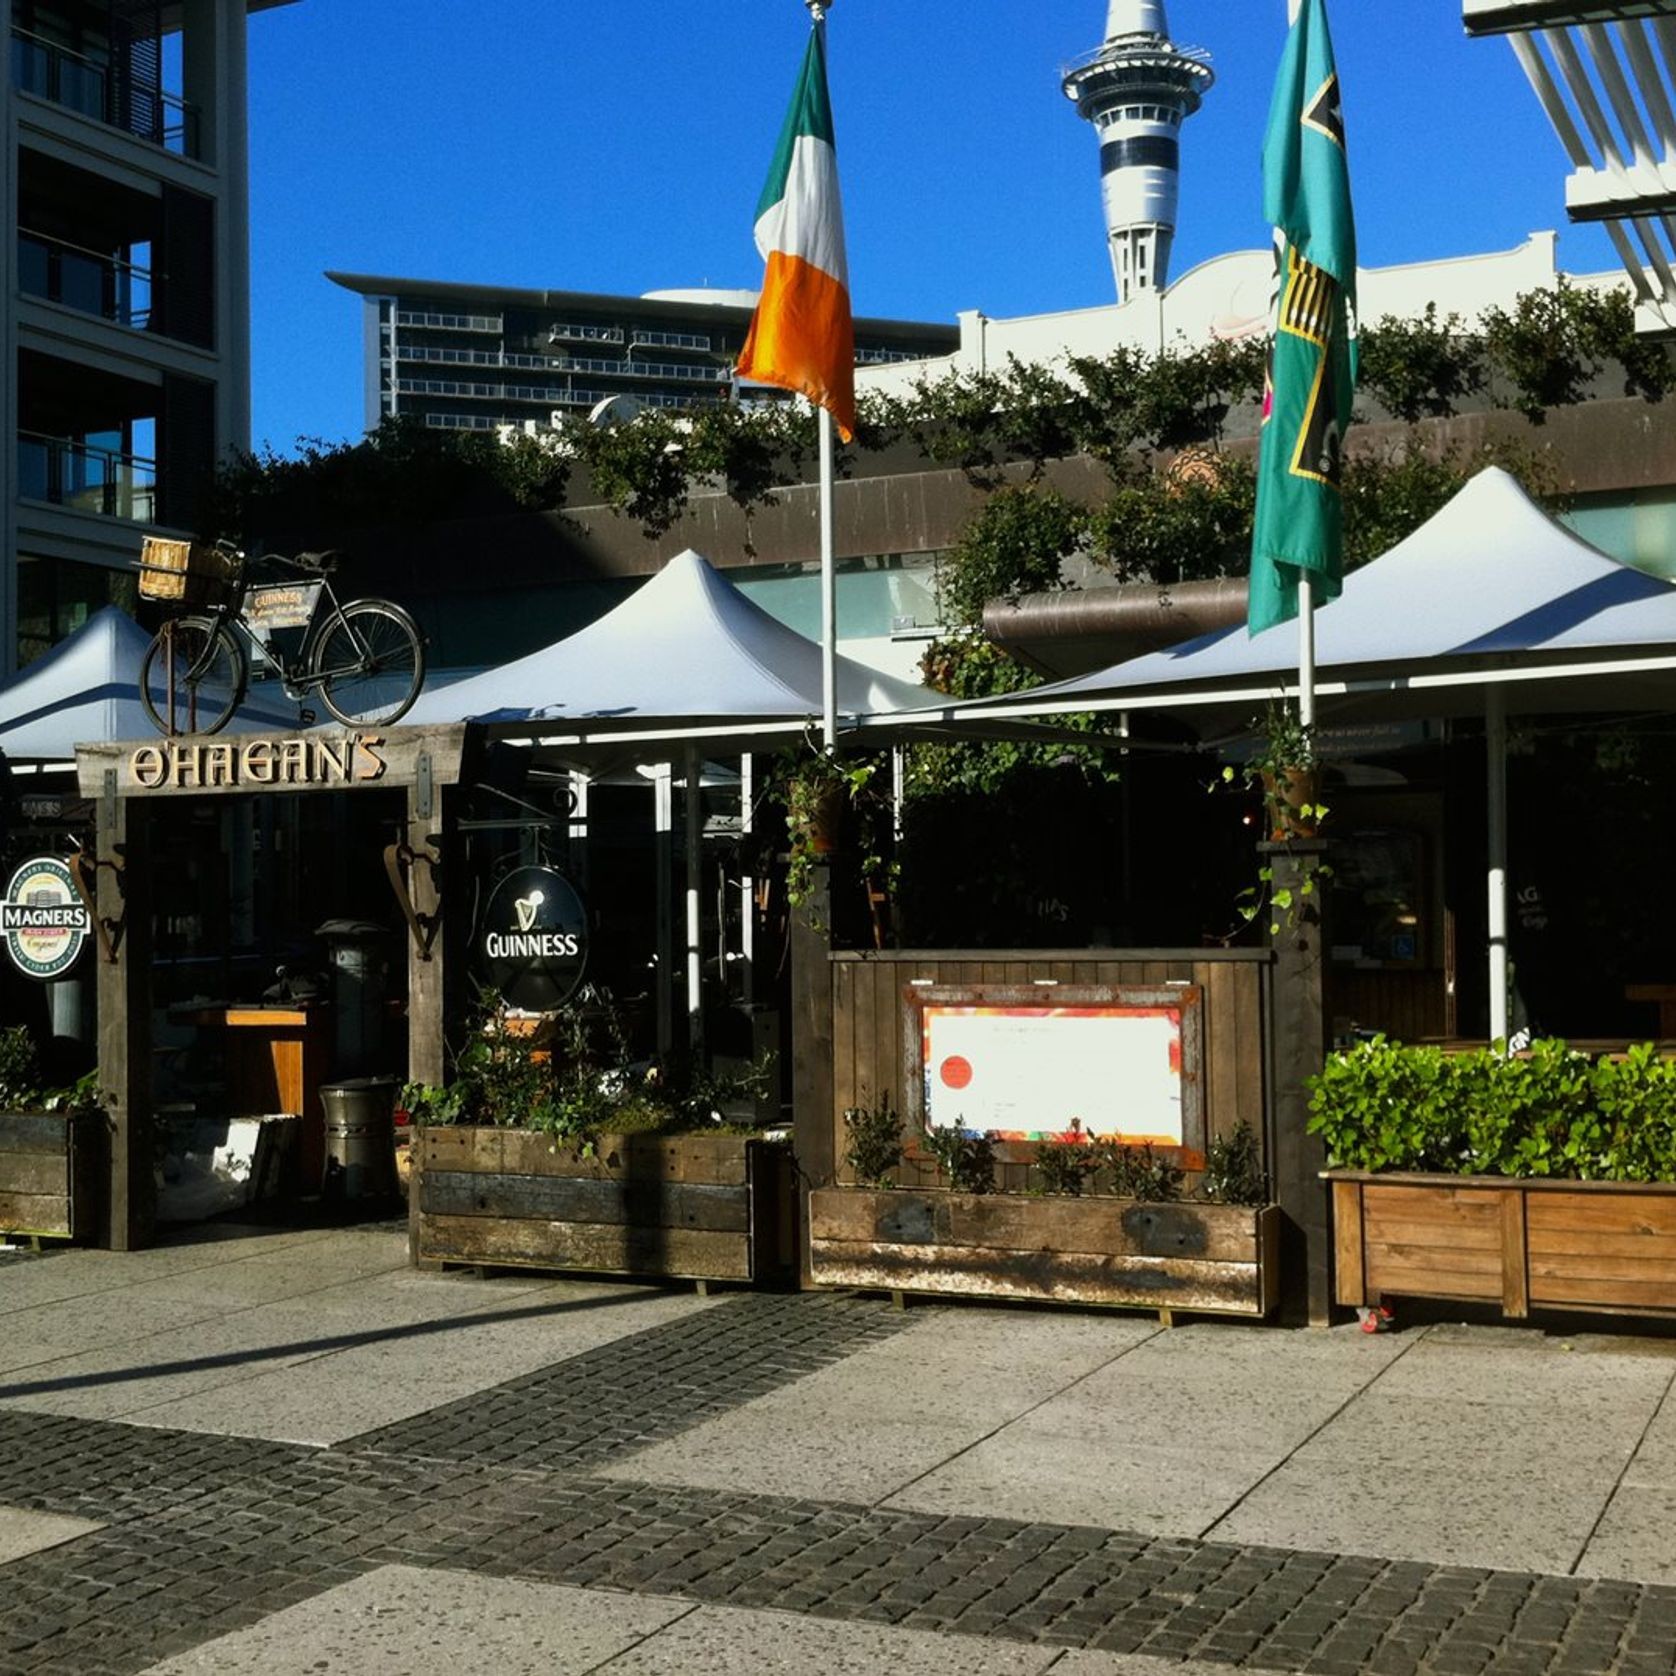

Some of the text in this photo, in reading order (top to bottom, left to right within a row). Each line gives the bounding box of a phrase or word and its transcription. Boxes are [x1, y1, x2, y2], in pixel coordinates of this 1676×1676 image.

[254, 591, 303, 607] GUINNESS
[129, 730, 386, 788] O'HAGAN'S
[4, 907, 85, 927] MAGNERS
[486, 932, 579, 958] GUINNESS
